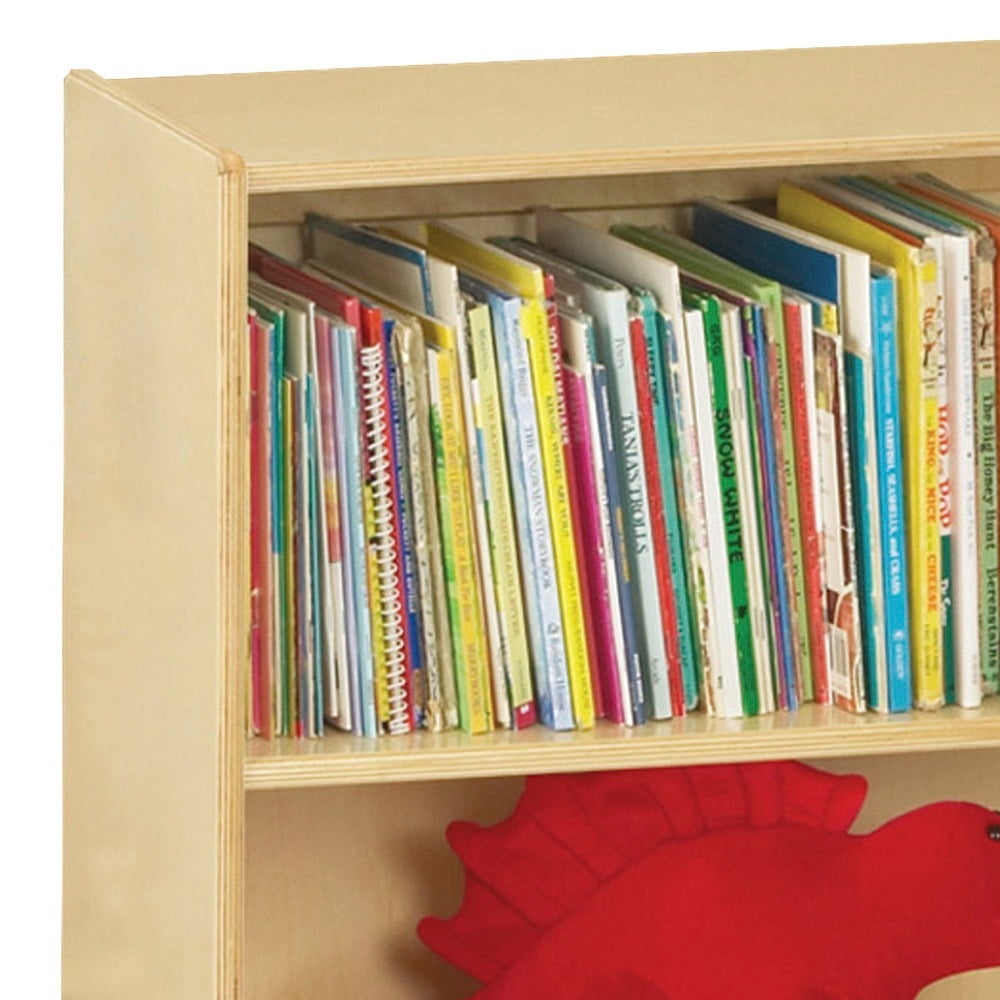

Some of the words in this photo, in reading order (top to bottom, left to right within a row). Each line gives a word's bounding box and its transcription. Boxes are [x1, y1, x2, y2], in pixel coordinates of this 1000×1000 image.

[938, 402, 951, 455] HOP
[981, 394, 994, 421] The
[715, 407, 734, 479] SNOW
[979, 424, 995, 452] Big
[939, 478, 953, 529] POP
[982, 454, 997, 505] Honey
[629, 483, 648, 555] TROLLS
[723, 486, 744, 564] WHITE
[926, 487, 937, 524] MICE
[984, 509, 997, 551] Hunt
[926, 554, 938, 613] CHEESE
